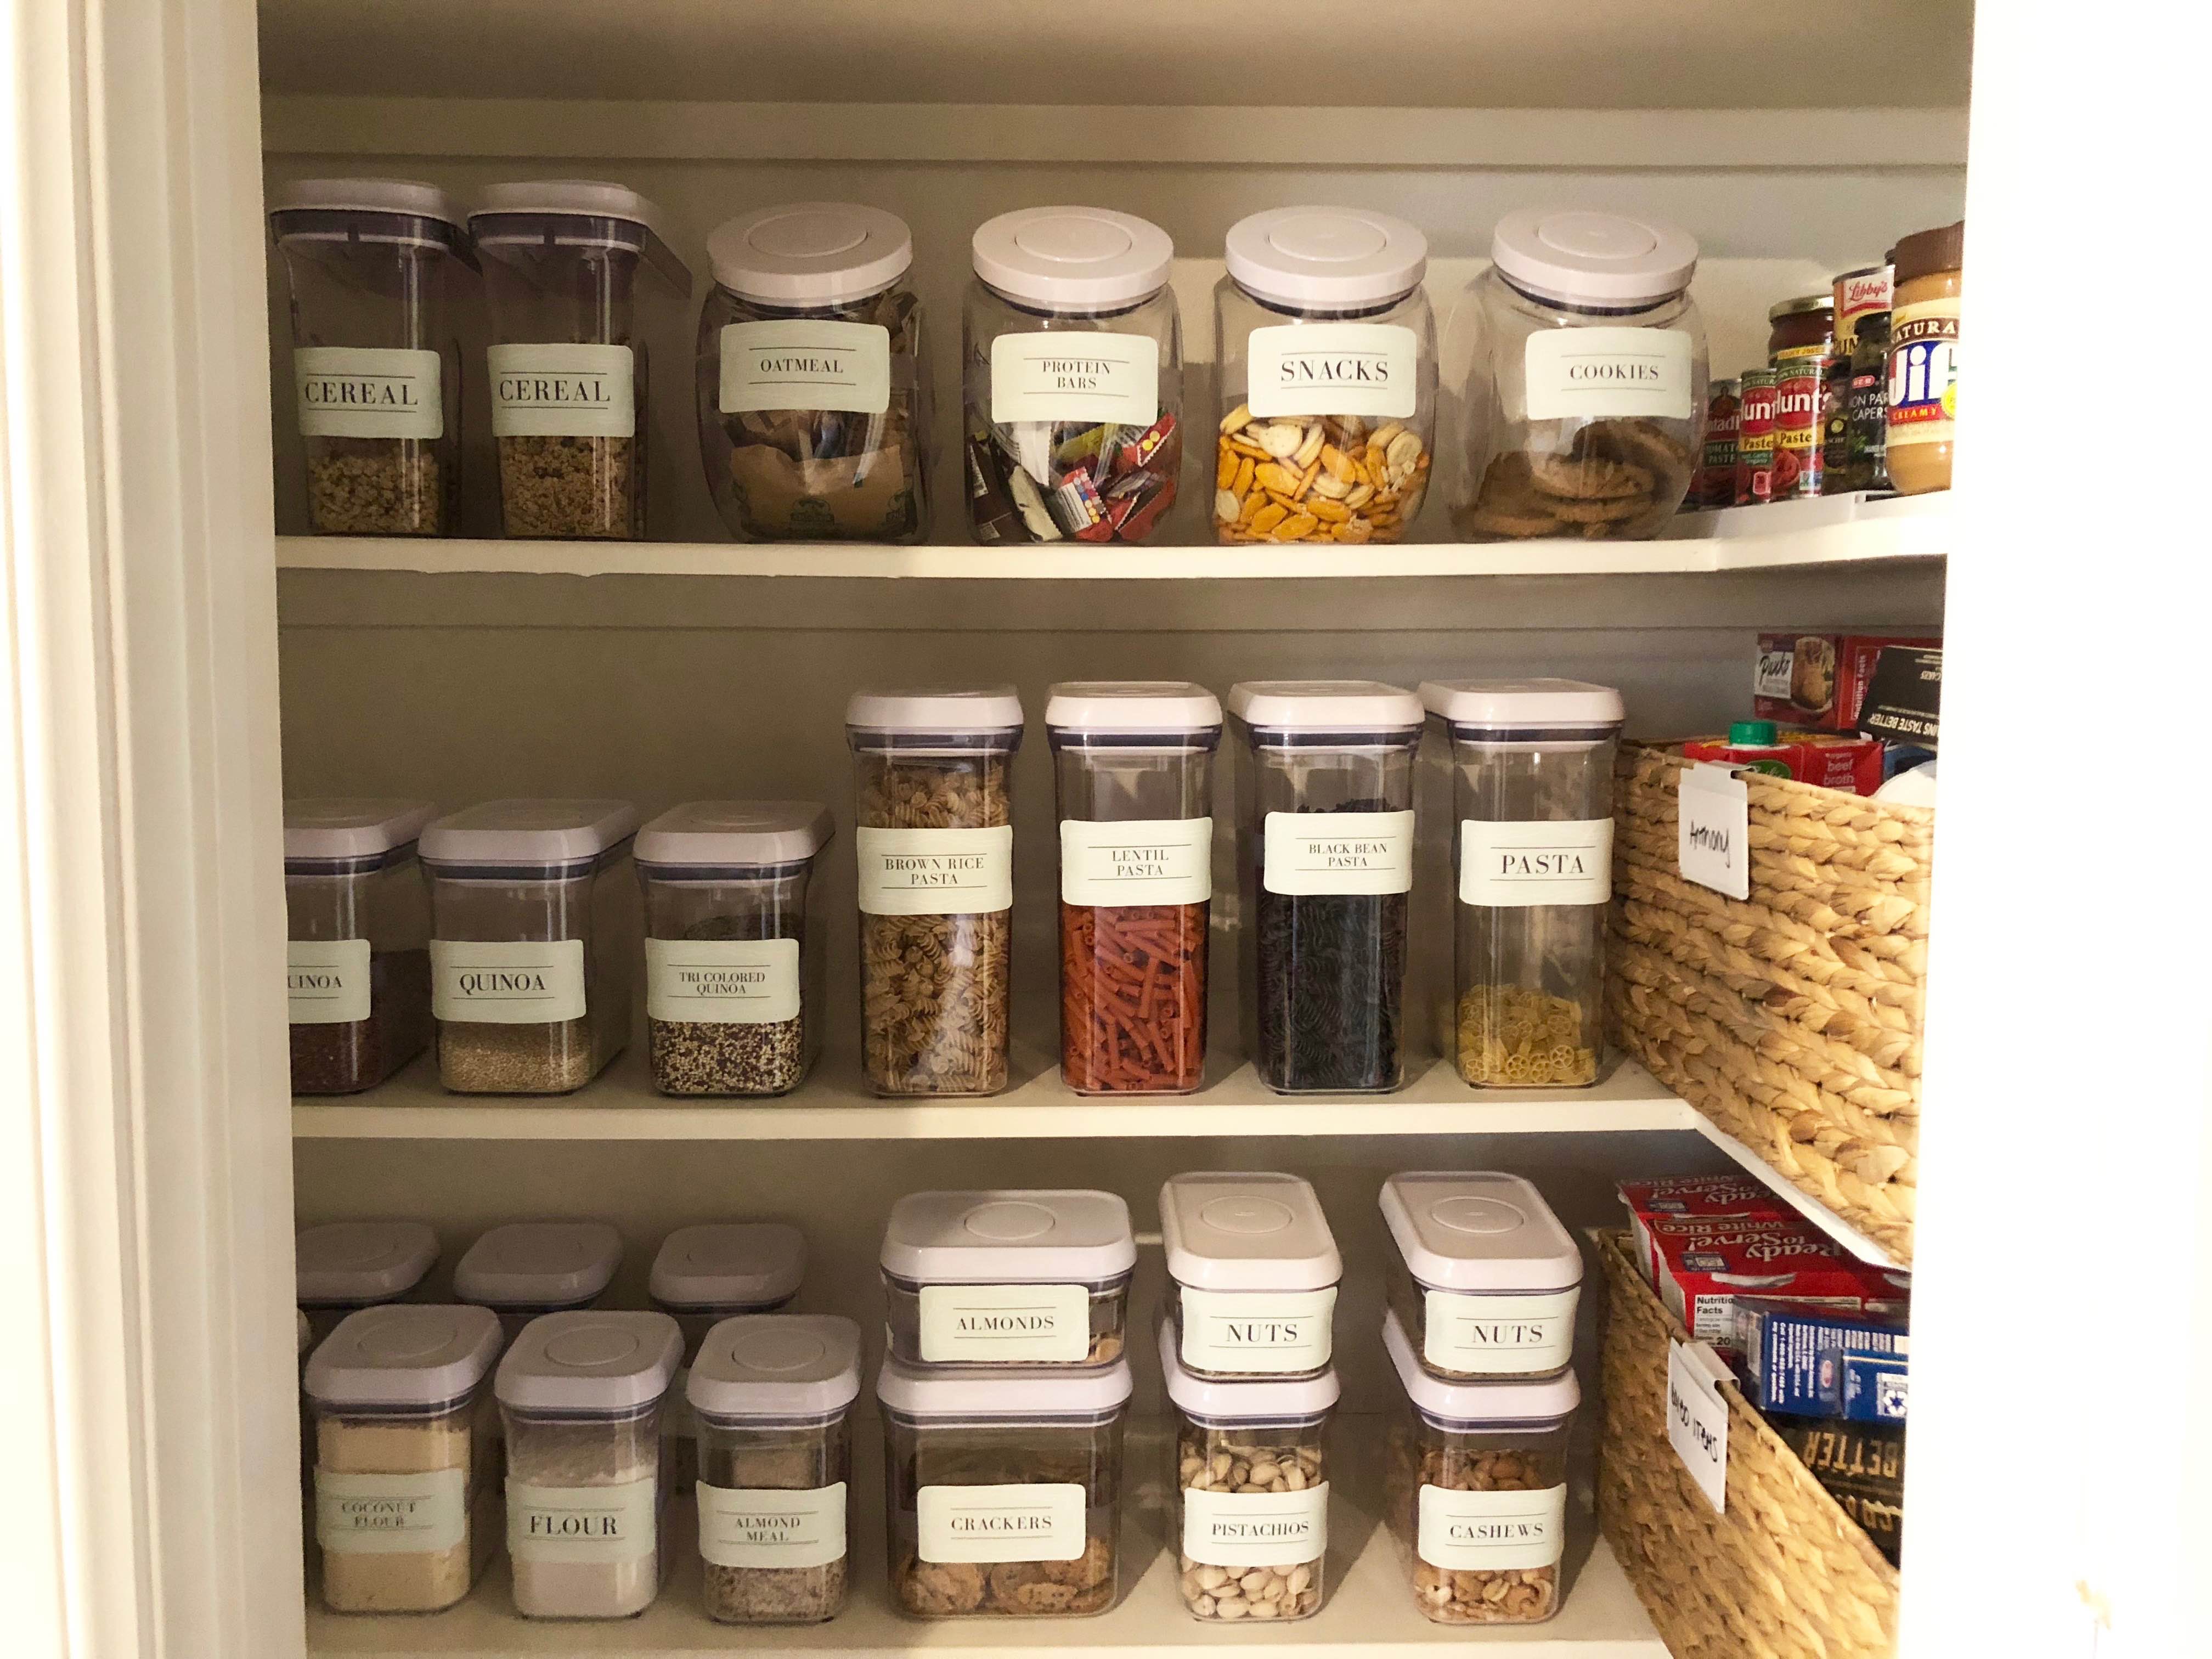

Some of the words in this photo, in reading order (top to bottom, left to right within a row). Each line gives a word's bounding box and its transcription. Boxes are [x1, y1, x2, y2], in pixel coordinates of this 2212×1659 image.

[1849, 280, 1888, 301] Libby's
[1892, 320, 1956, 342] ATURA
[761, 359, 843, 373] OATMEAL
[1043, 361, 1109, 374] PROTEIN
[1282, 361, 1387, 381] SNACKS
[1570, 365, 1658, 379] COOKIES
[1889, 341, 1958, 407] Jif
[1058, 377, 1096, 388] BARS
[304, 382, 418, 406] CEREAL
[500, 380, 610, 402] CEREAL
[1893, 408, 1937, 420] CREAMY
[1743, 439, 1774, 449] Paste
[1780, 432, 1812, 445] Paste
[1870, 714, 1898, 729] BETTER
[1898, 719, 1923, 733] TASTE
[1827, 759, 1853, 772] beef
[1824, 774, 1855, 786] broth
[1308, 843, 1349, 854] BLACK
[1356, 844, 1386, 853] BEAN
[1113, 850, 1168, 861] LENTIL
[1329, 857, 1367, 866] PASTA
[885, 859, 940, 870] BROWN
[949, 858, 983, 869] RICE
[1117, 864, 1164, 876] PASTA
[1501, 854, 1584, 874] PASTA
[911, 874, 958, 885] PASTA
[287, 974, 342, 989] UINOA
[459, 974, 545, 992] QUINOA
[680, 972, 699, 982] TRI
[704, 972, 765, 983] COLORED
[696, 984, 747, 995] QUINOA
[1662, 1224, 1713, 1234] Rice
[1717, 1222, 1783, 1232] White
[1689, 1232, 1781, 1251] Serve!
[1746, 1243, 1842, 1262] Ready
[956, 1316, 1054, 1331] ALMONDS
[1227, 1324, 1297, 1342] NUTS
[1472, 1325, 1542, 1343] NUTS
[1803, 1431, 1900, 1478] BETTER
[340, 1502, 416, 1514] COCONUT
[354, 1516, 404, 1528] FLOUR
[531, 1516, 616, 1534] FLOUR
[735, 1517, 800, 1528] ALMOND
[952, 1517, 1051, 1530] CRACKERS
[1212, 1521, 1310, 1537] PISTACHIOS
[1449, 1522, 1544, 1539] CASHEWS
[747, 1532, 788, 1541] MEAL
